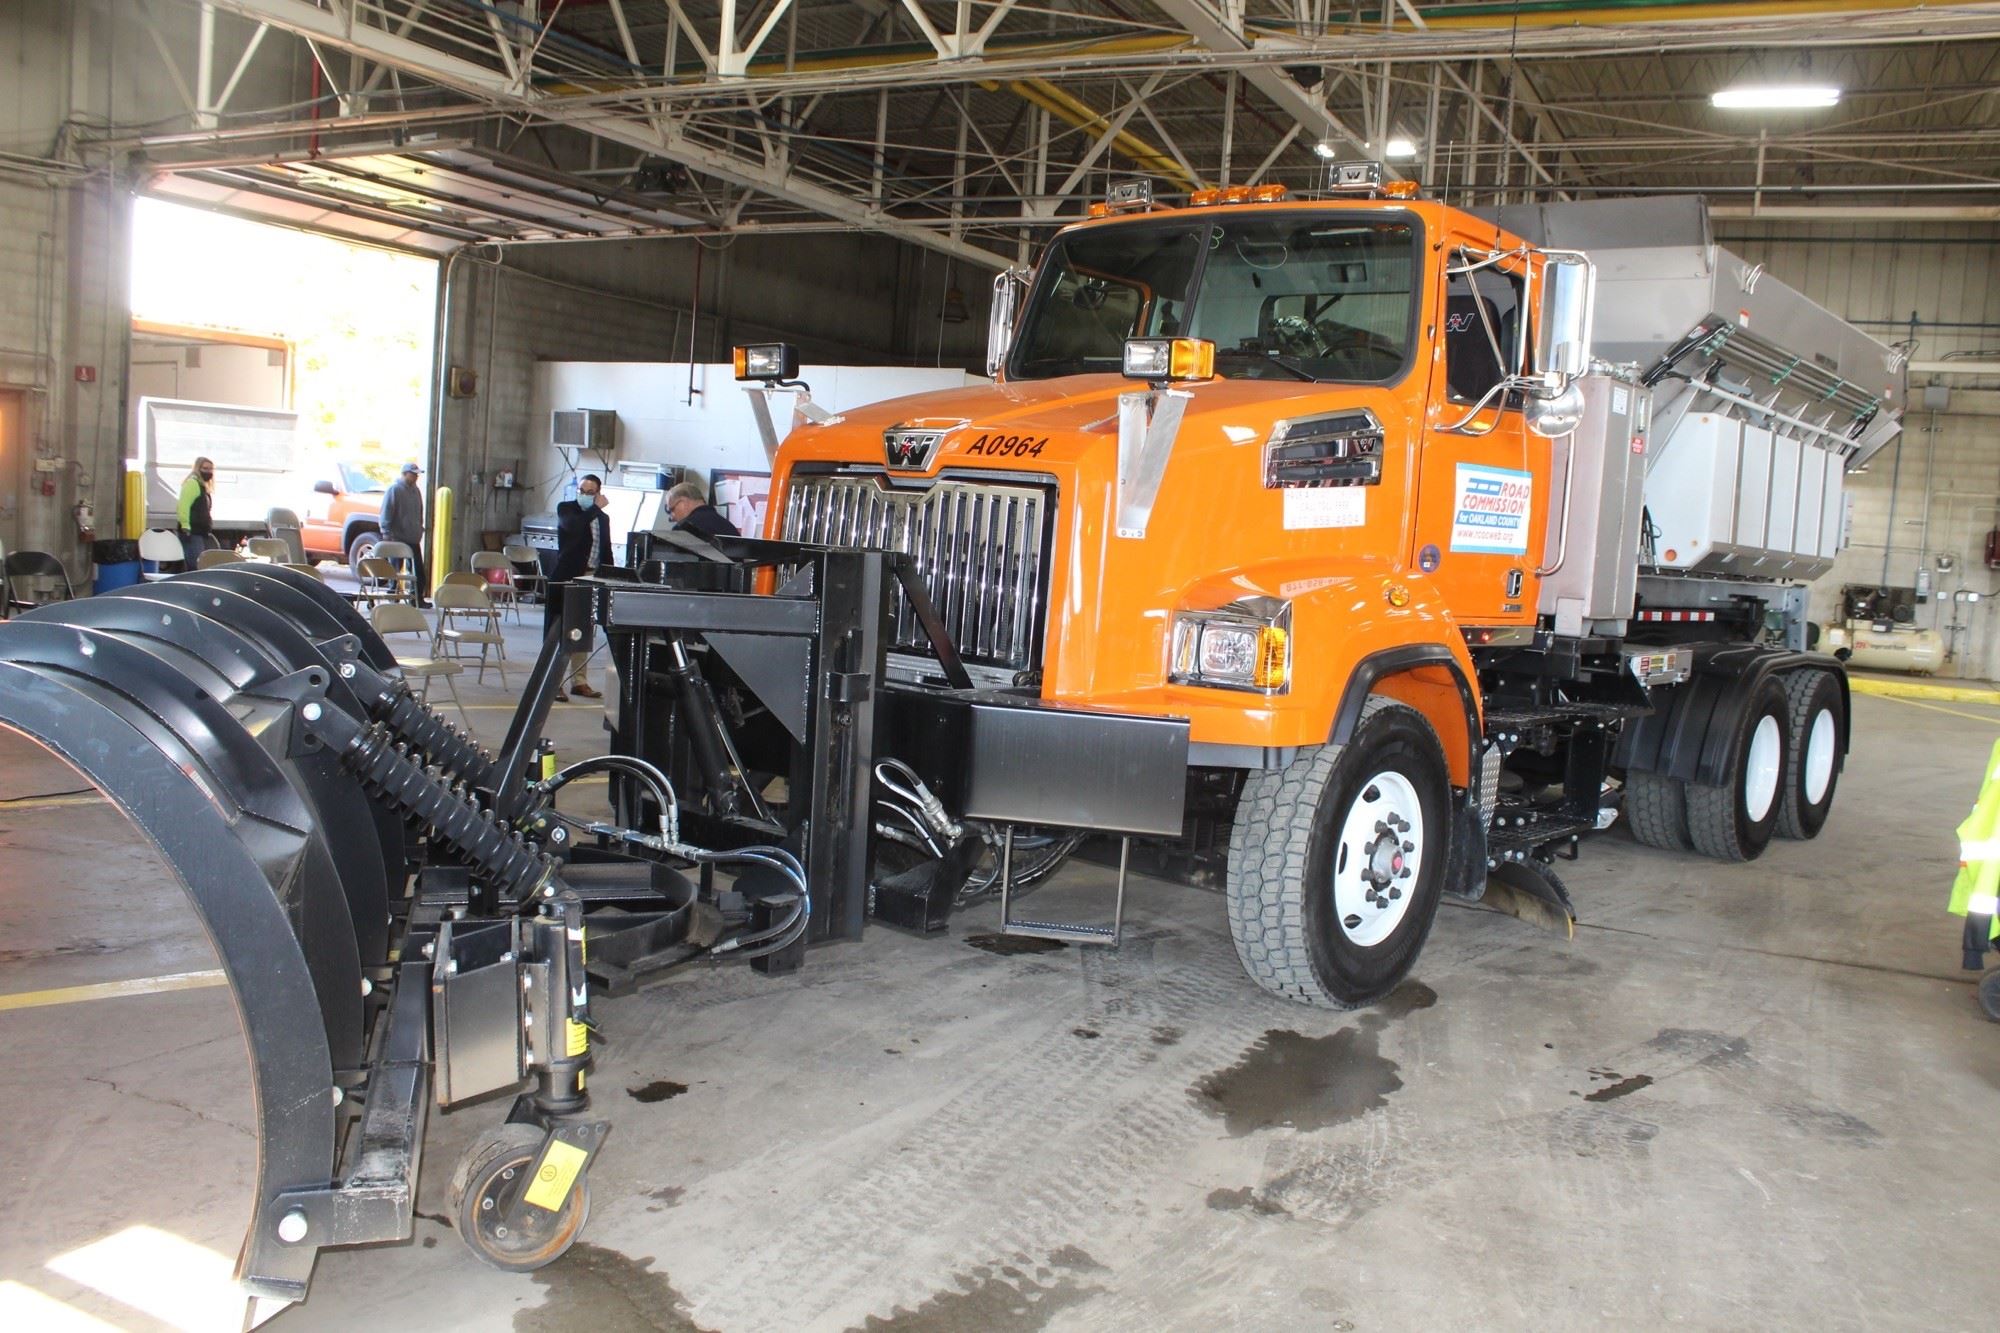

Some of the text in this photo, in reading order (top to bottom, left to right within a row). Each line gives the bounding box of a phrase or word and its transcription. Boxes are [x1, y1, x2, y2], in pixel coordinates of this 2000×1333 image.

[966, 434, 1049, 458] A0964
[1500, 481, 1530, 499] ROAD
[1462, 494, 1526, 514] COMMISSION
[1458, 512, 1521, 527] for OAKLAND COUNTY
